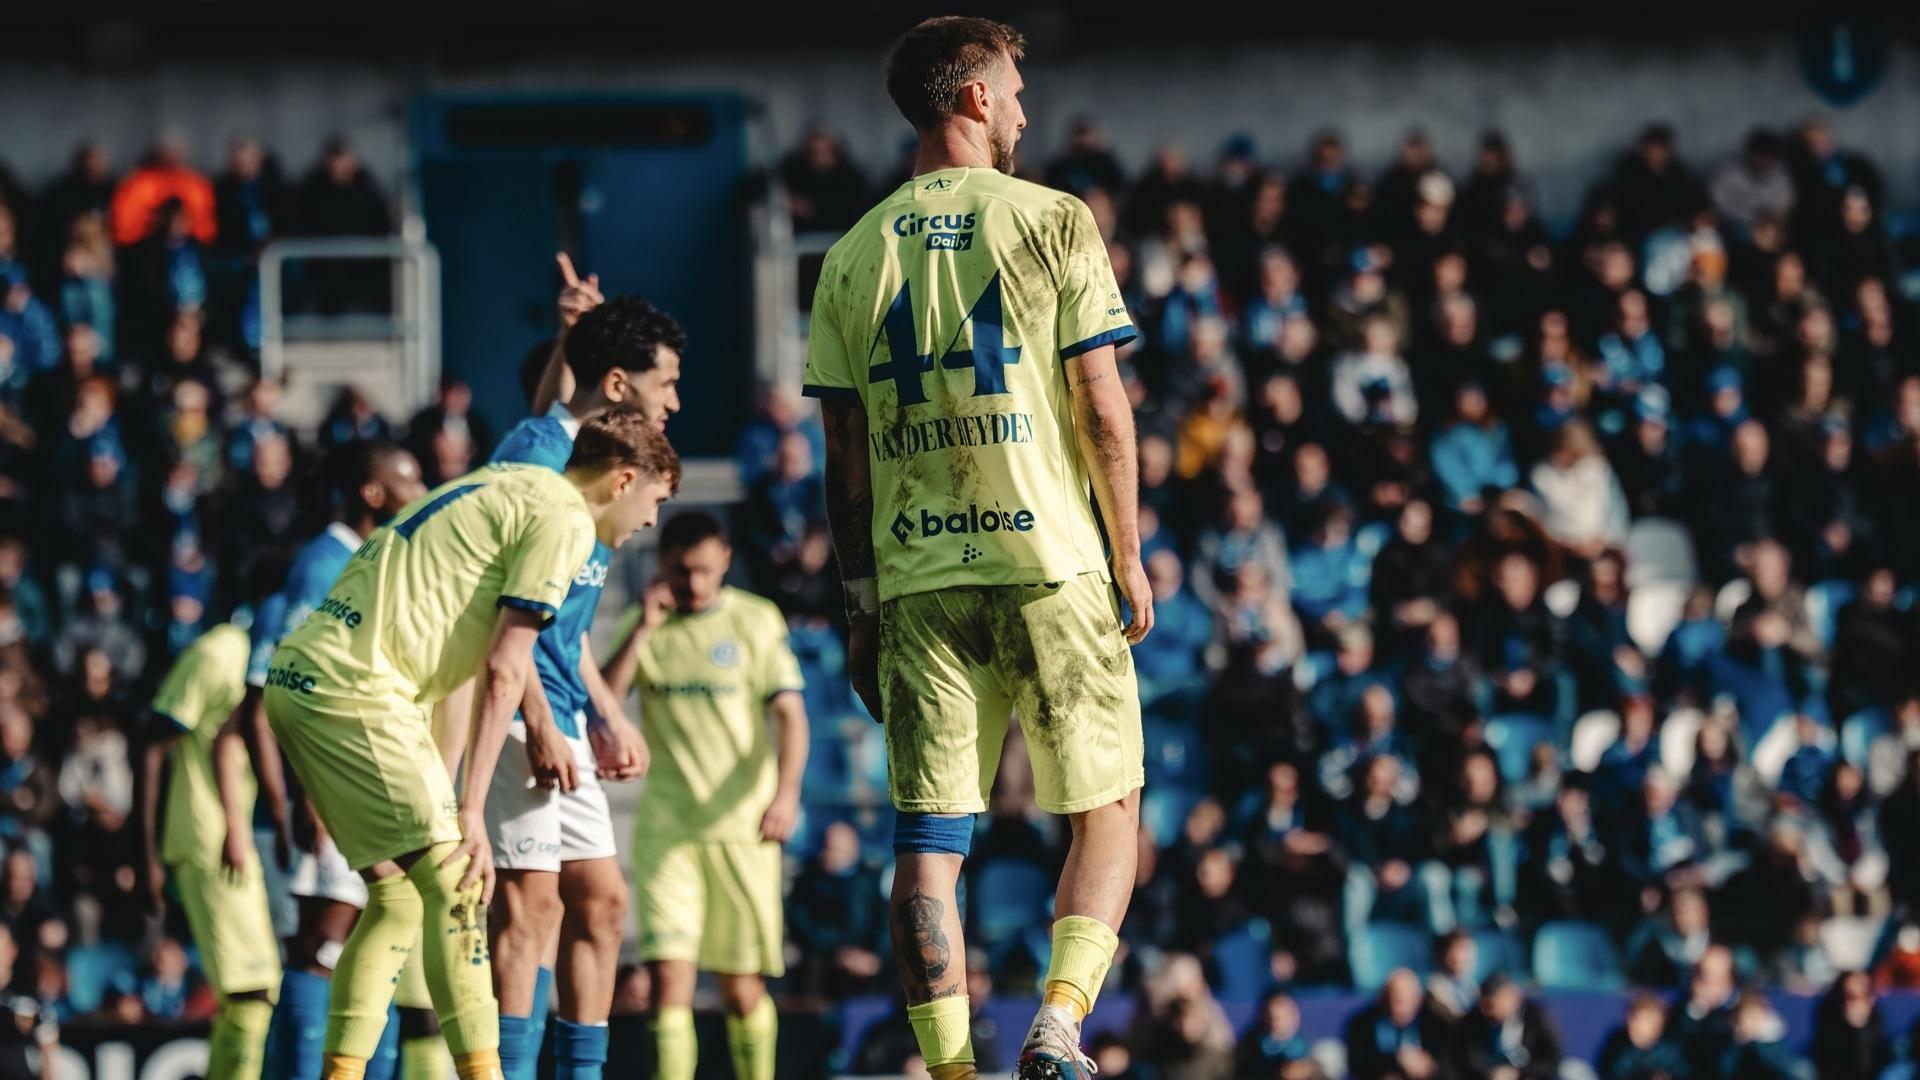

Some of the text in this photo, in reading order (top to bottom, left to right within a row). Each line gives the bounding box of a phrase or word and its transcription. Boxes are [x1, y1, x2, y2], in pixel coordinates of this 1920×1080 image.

[893, 212, 976, 237] Circus
[931, 233, 968, 250] Daily
[869, 268, 1022, 408] 44
[906, 418, 955, 455] DER
[920, 501, 1035, 538] baloise
